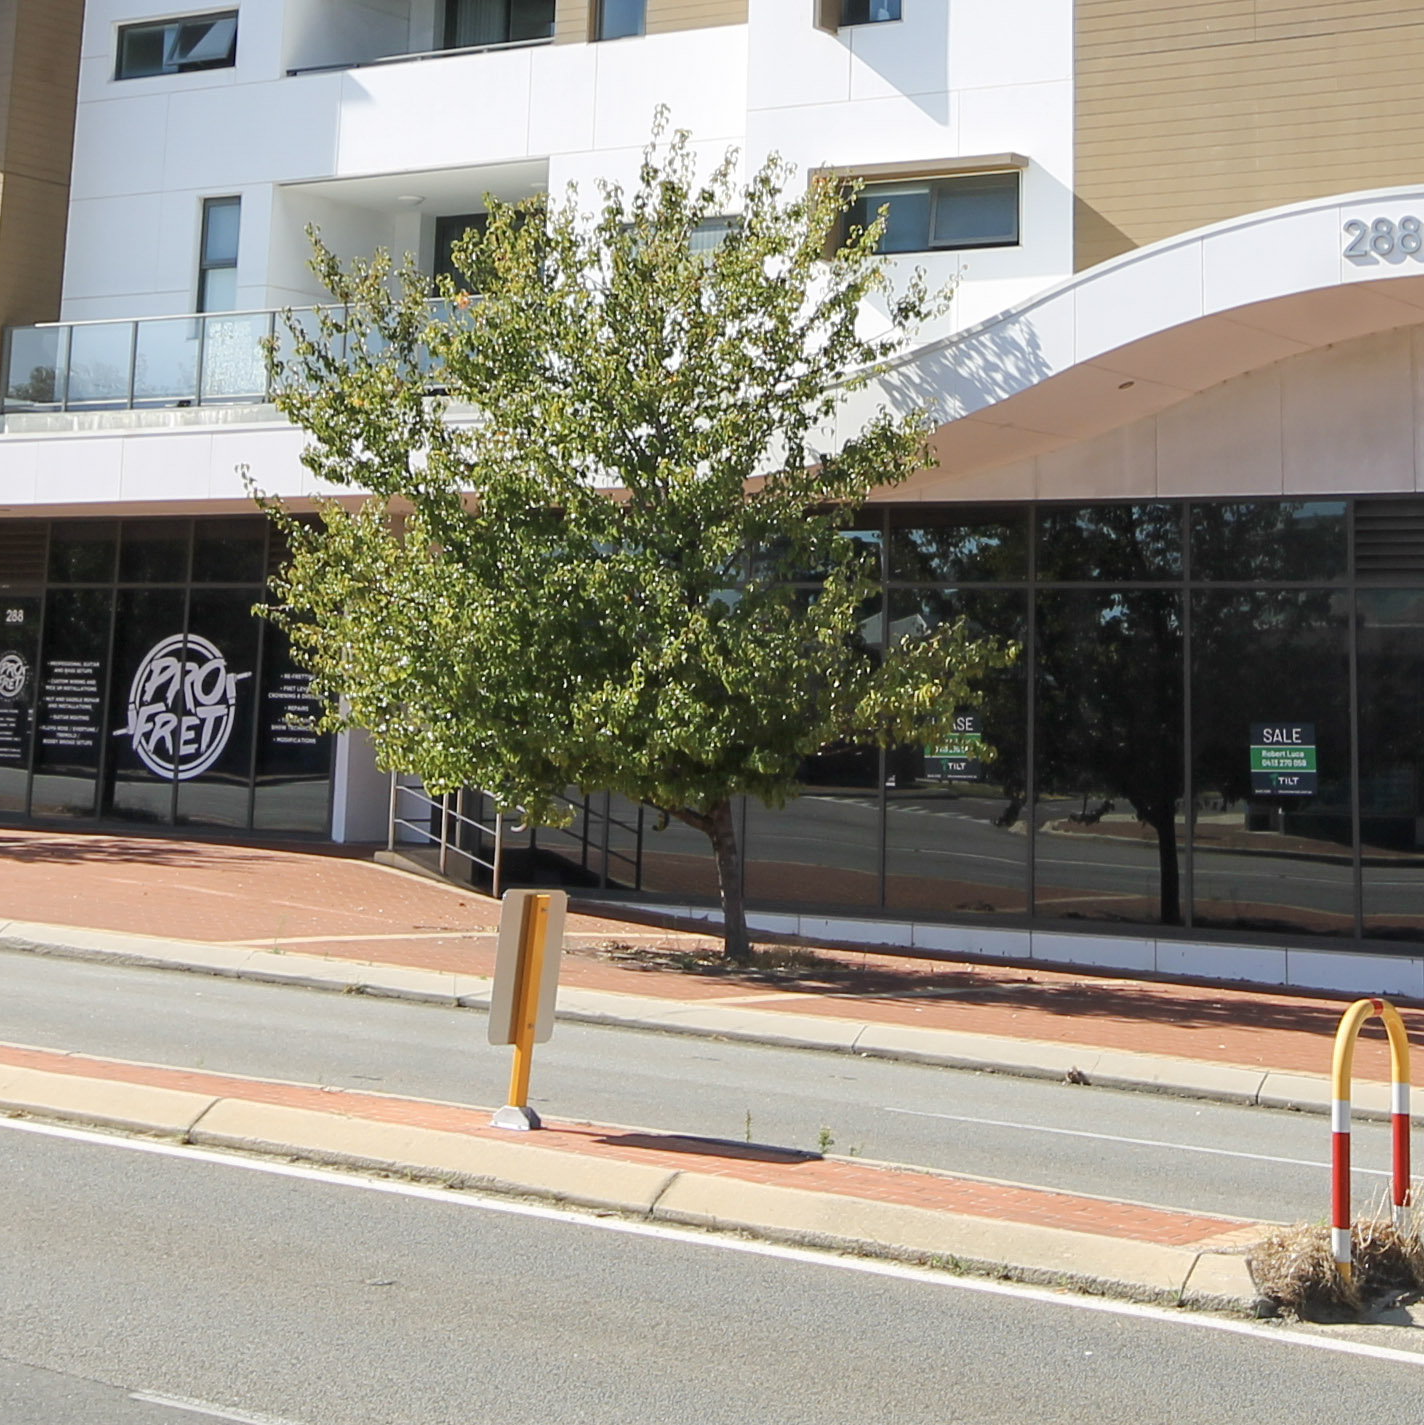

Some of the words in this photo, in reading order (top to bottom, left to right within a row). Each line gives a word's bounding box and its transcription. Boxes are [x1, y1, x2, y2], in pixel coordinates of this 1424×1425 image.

[5, 609, 24, 623] 288
[143, 656, 228, 714] PRO
[132, 702, 229, 756] FRET
[1262, 727, 1303, 744] SALE
[1261, 749, 1286, 758] Robert
[947, 762, 967, 771] TILT
[1278, 776, 1300, 785] TILT
